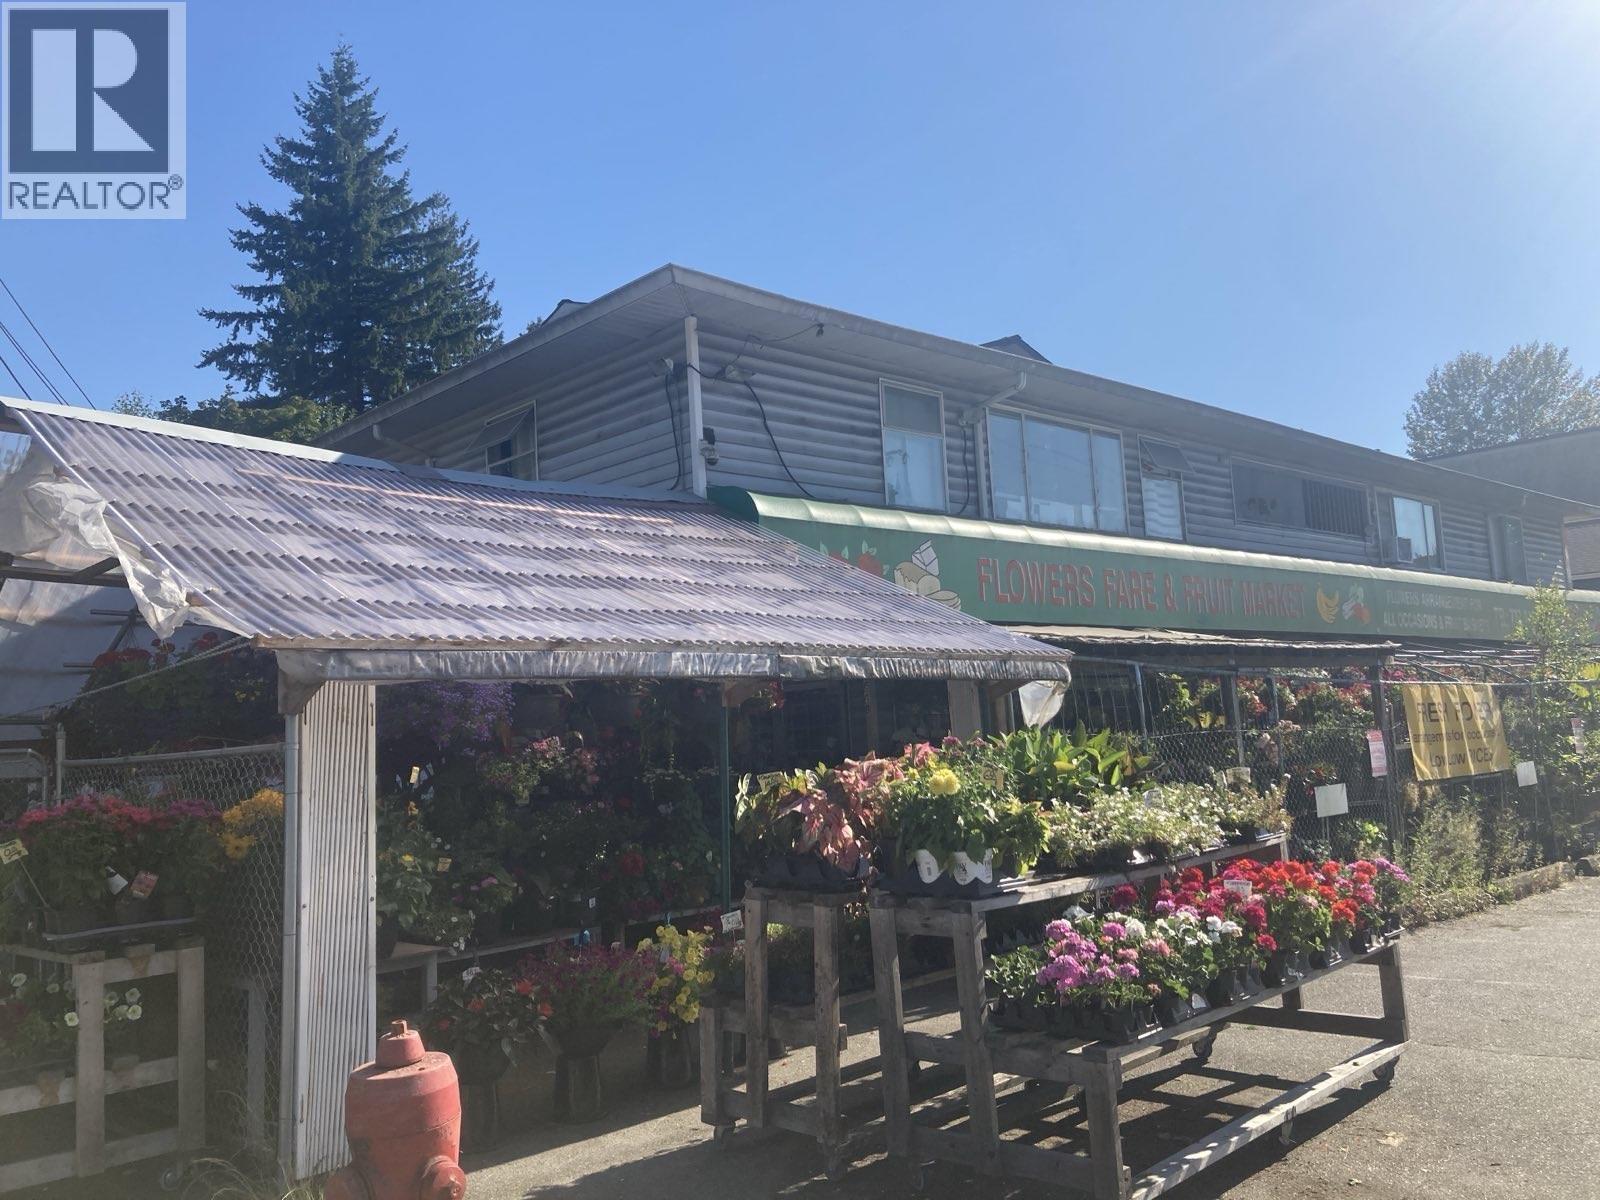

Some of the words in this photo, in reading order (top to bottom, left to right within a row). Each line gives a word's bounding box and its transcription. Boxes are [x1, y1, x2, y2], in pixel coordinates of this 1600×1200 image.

[976, 557, 1096, 609] FLOWERS
[1103, 568, 1158, 611] FARE
[1163, 572, 1179, 612] &
[1182, 575, 1236, 615] FRUIT
[1241, 580, 1306, 618] MARKET
